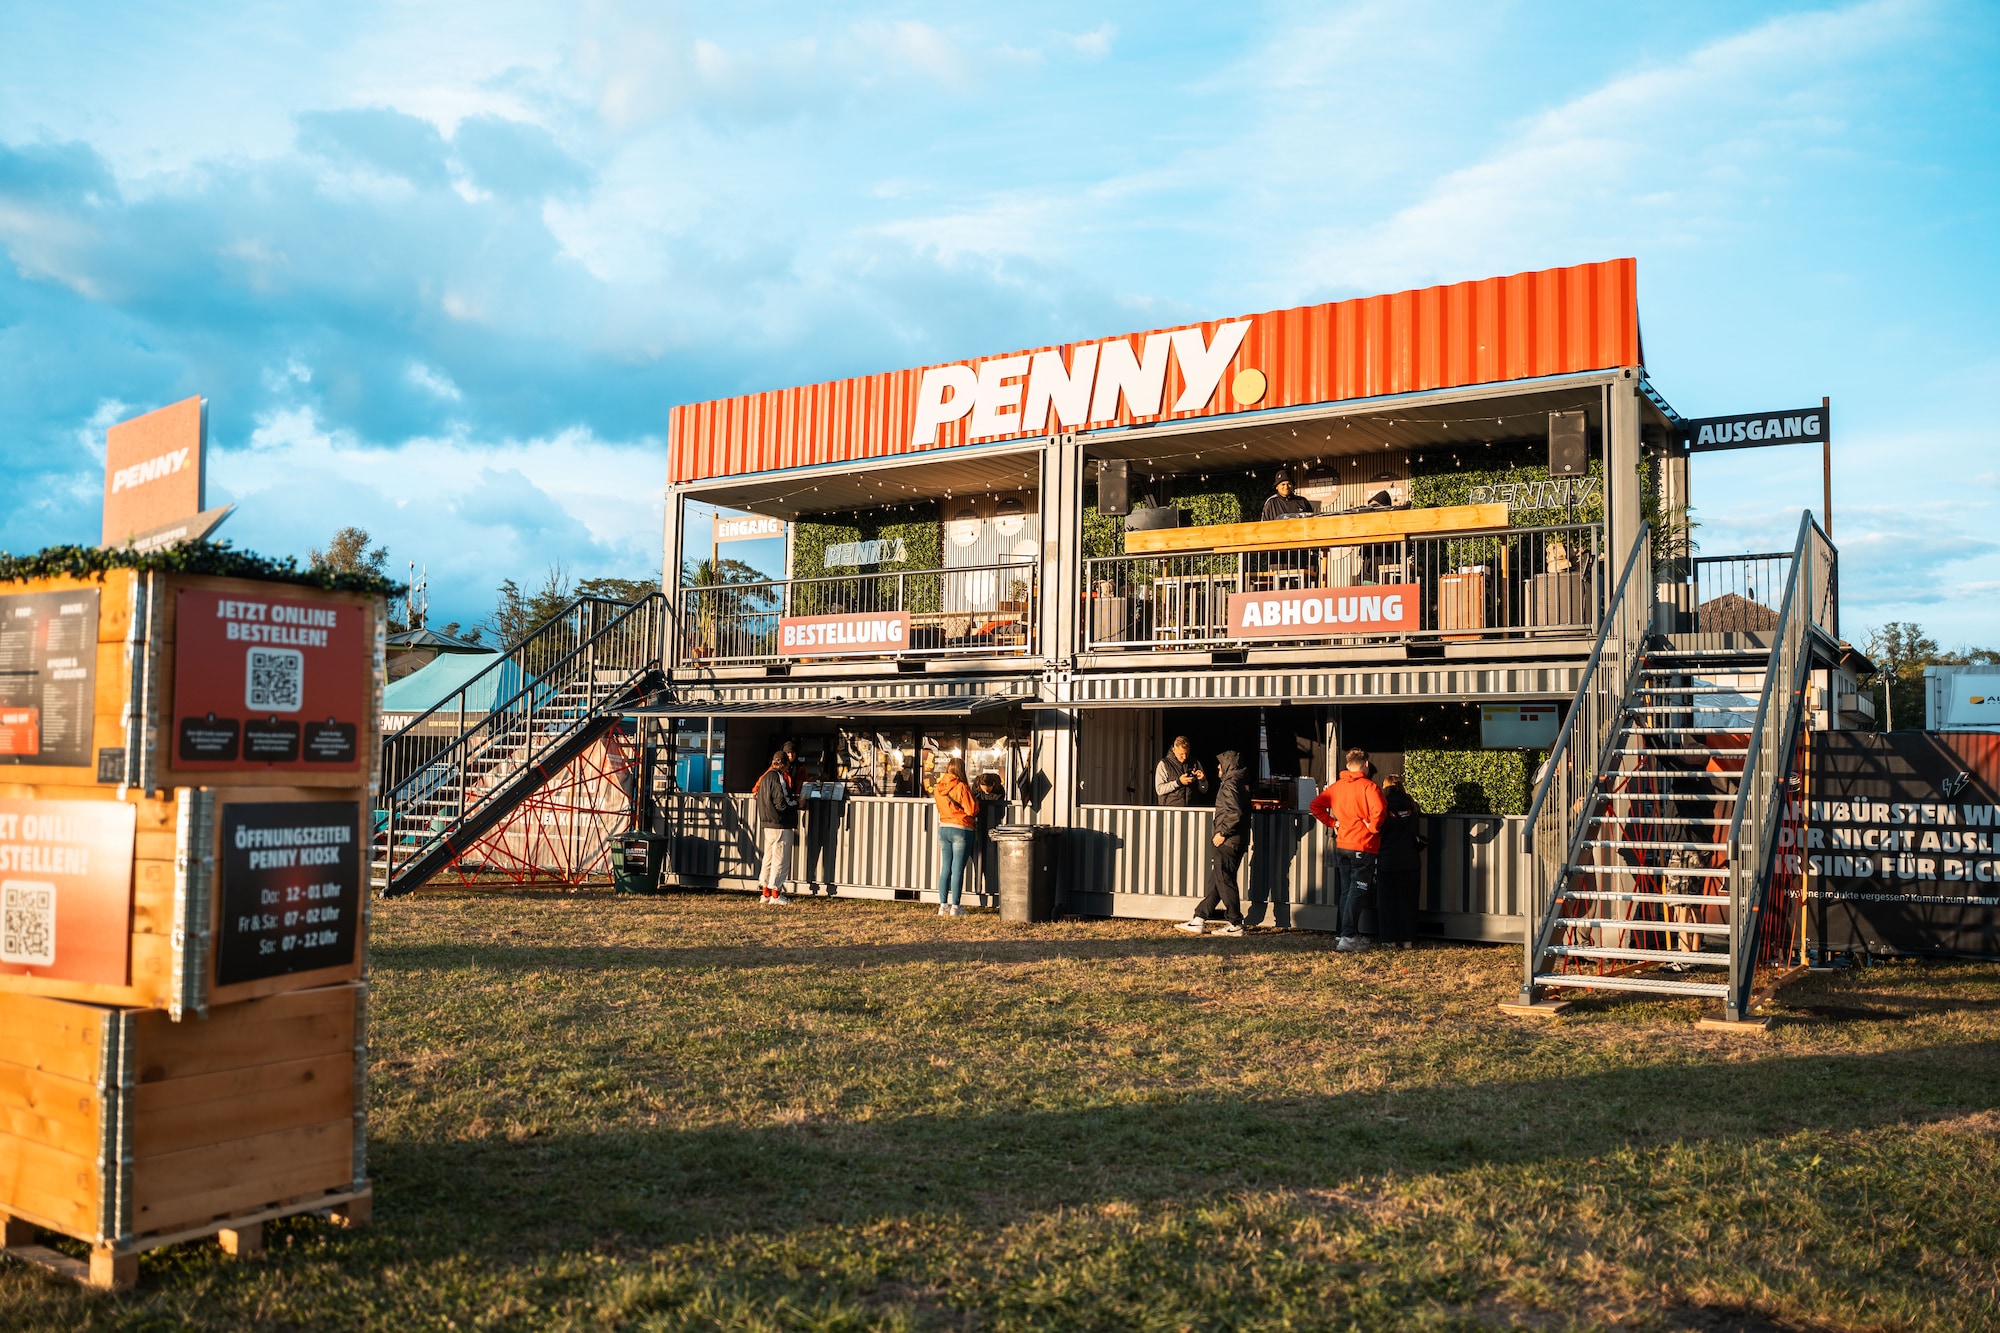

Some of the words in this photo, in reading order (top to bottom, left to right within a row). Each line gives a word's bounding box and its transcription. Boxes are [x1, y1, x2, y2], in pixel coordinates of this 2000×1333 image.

[1697, 415, 1821, 445] AUSGANG
[718, 518, 778, 538] EINGANG
[217, 600, 267, 621] JETZT
[271, 605, 337, 628] ONLINE
[1242, 595, 1404, 628] ABHOLUNG
[226, 622, 328, 647] BESTELLEN!
[783, 619, 903, 649] BESTELLUNG
[1783, 796, 1957, 827] AHNBÜRSTEN
[235, 825, 350, 849] ÖFFNUNGSZEITEN
[1779, 827, 1826, 849] DIR
[1832, 828, 1916, 851] NICHT
[249, 849, 298, 870] PENNY
[300, 846, 340, 866] KIOSK
[1774, 853, 1802, 875] IR
[1808, 854, 1874, 877] SIND
[1882, 852, 1937, 879] FÜR
[1861, 890, 1910, 903] vergessen?
[1911, 893, 1944, 904] Kommt
[1945, 896, 1966, 904] zum
[1967, 896, 2000, 905] PENNY
